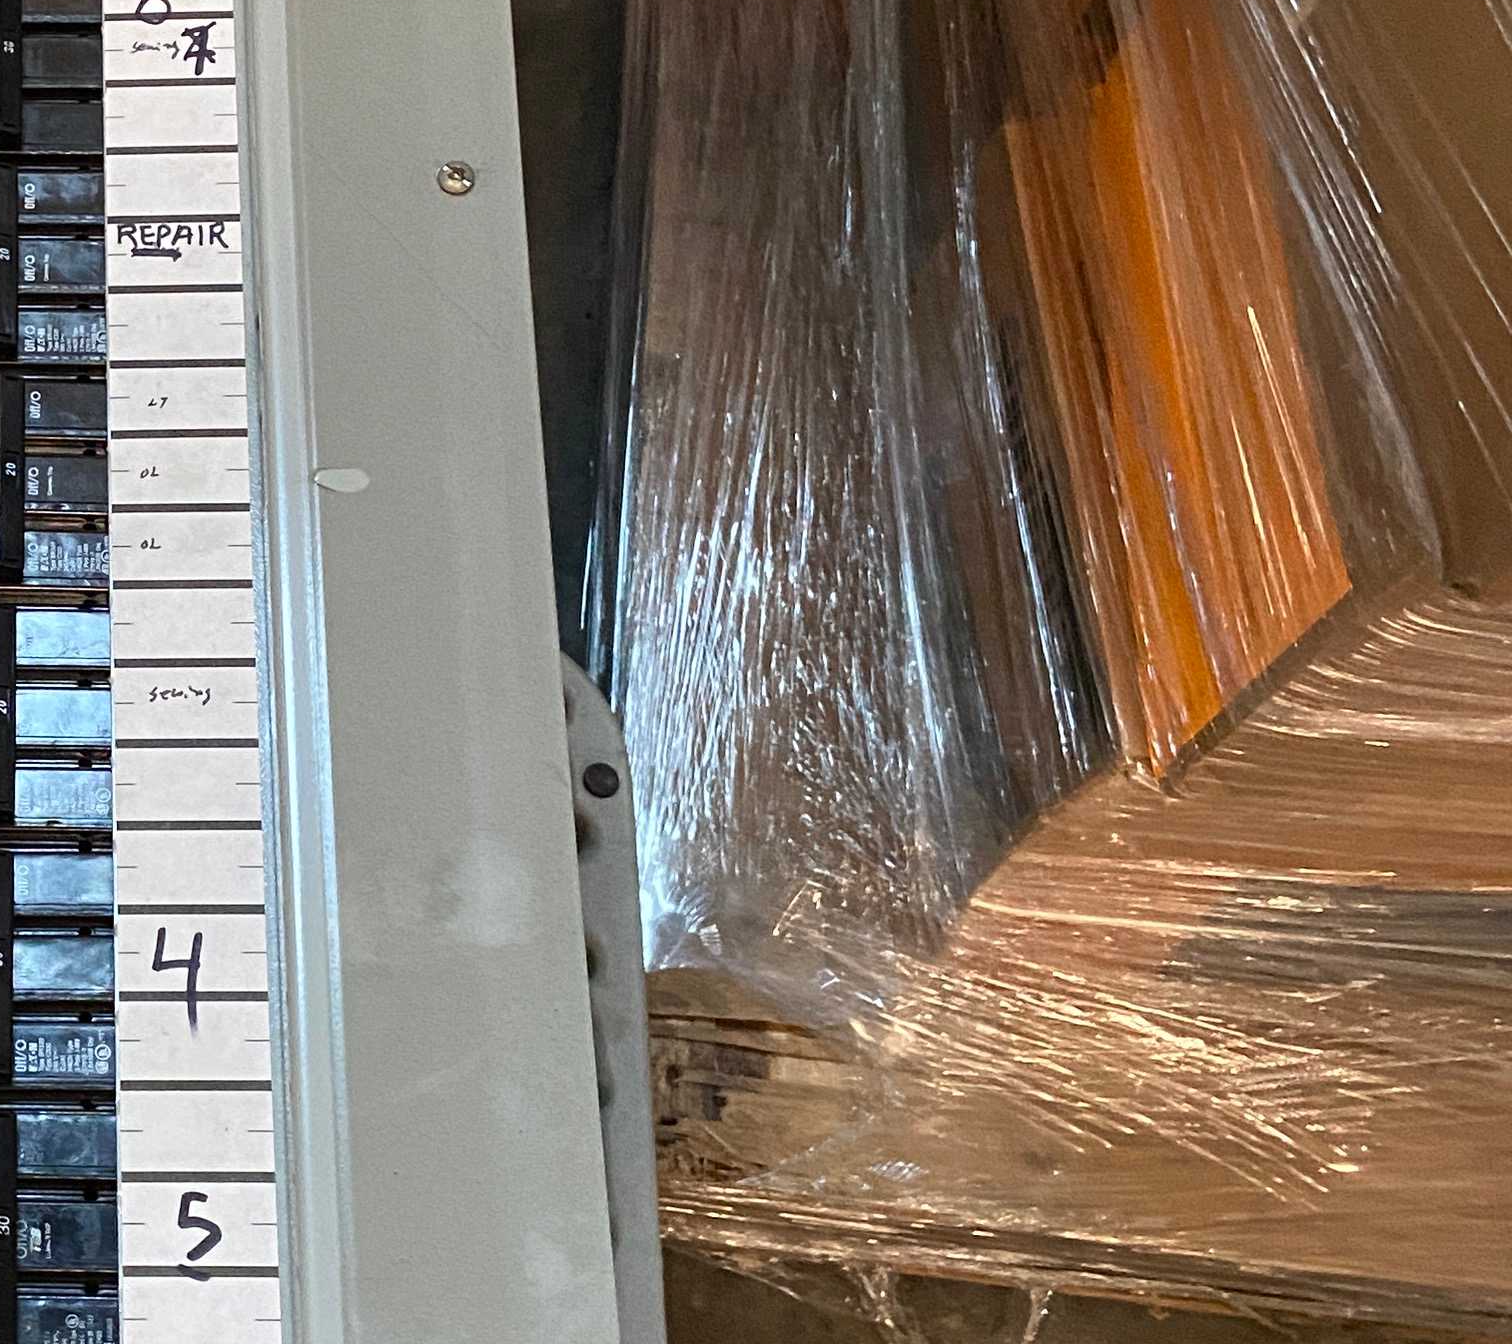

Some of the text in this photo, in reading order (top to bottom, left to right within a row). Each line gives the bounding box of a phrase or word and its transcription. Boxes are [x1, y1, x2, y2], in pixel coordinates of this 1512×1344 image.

[3, 39, 16, 54] 30
[116, 221, 229, 249] REPAIR
[0, 246, 11, 262] 20
[5, 462, 17, 477] 20
[151, 926, 204, 1033] 4
[177, 1190, 223, 1281] 5
